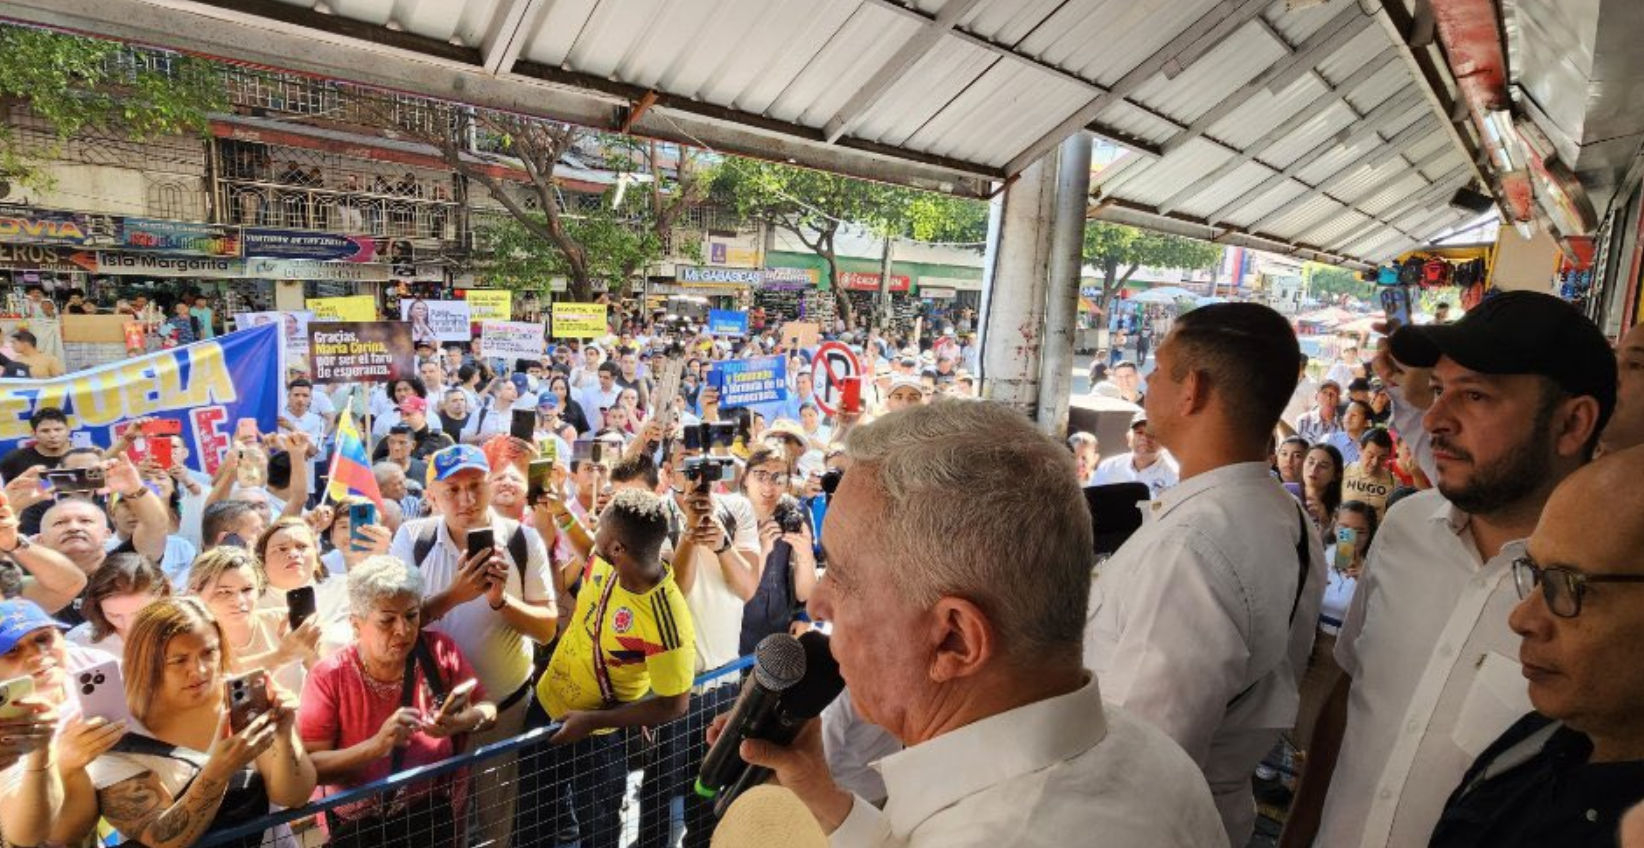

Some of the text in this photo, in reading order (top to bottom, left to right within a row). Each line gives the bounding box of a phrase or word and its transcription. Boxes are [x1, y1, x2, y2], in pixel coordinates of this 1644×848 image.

[102, 252, 228, 272] Isla Margarita
[314, 330, 359, 344] Gracias,
[350, 340, 388, 353] Corina,
[316, 352, 392, 369] por ser el faro
[317, 365, 391, 378] de esperanza.
[764, 379, 775, 389] de
[776, 378, 784, 388] la
[1347, 479, 1386, 495] HUGO
